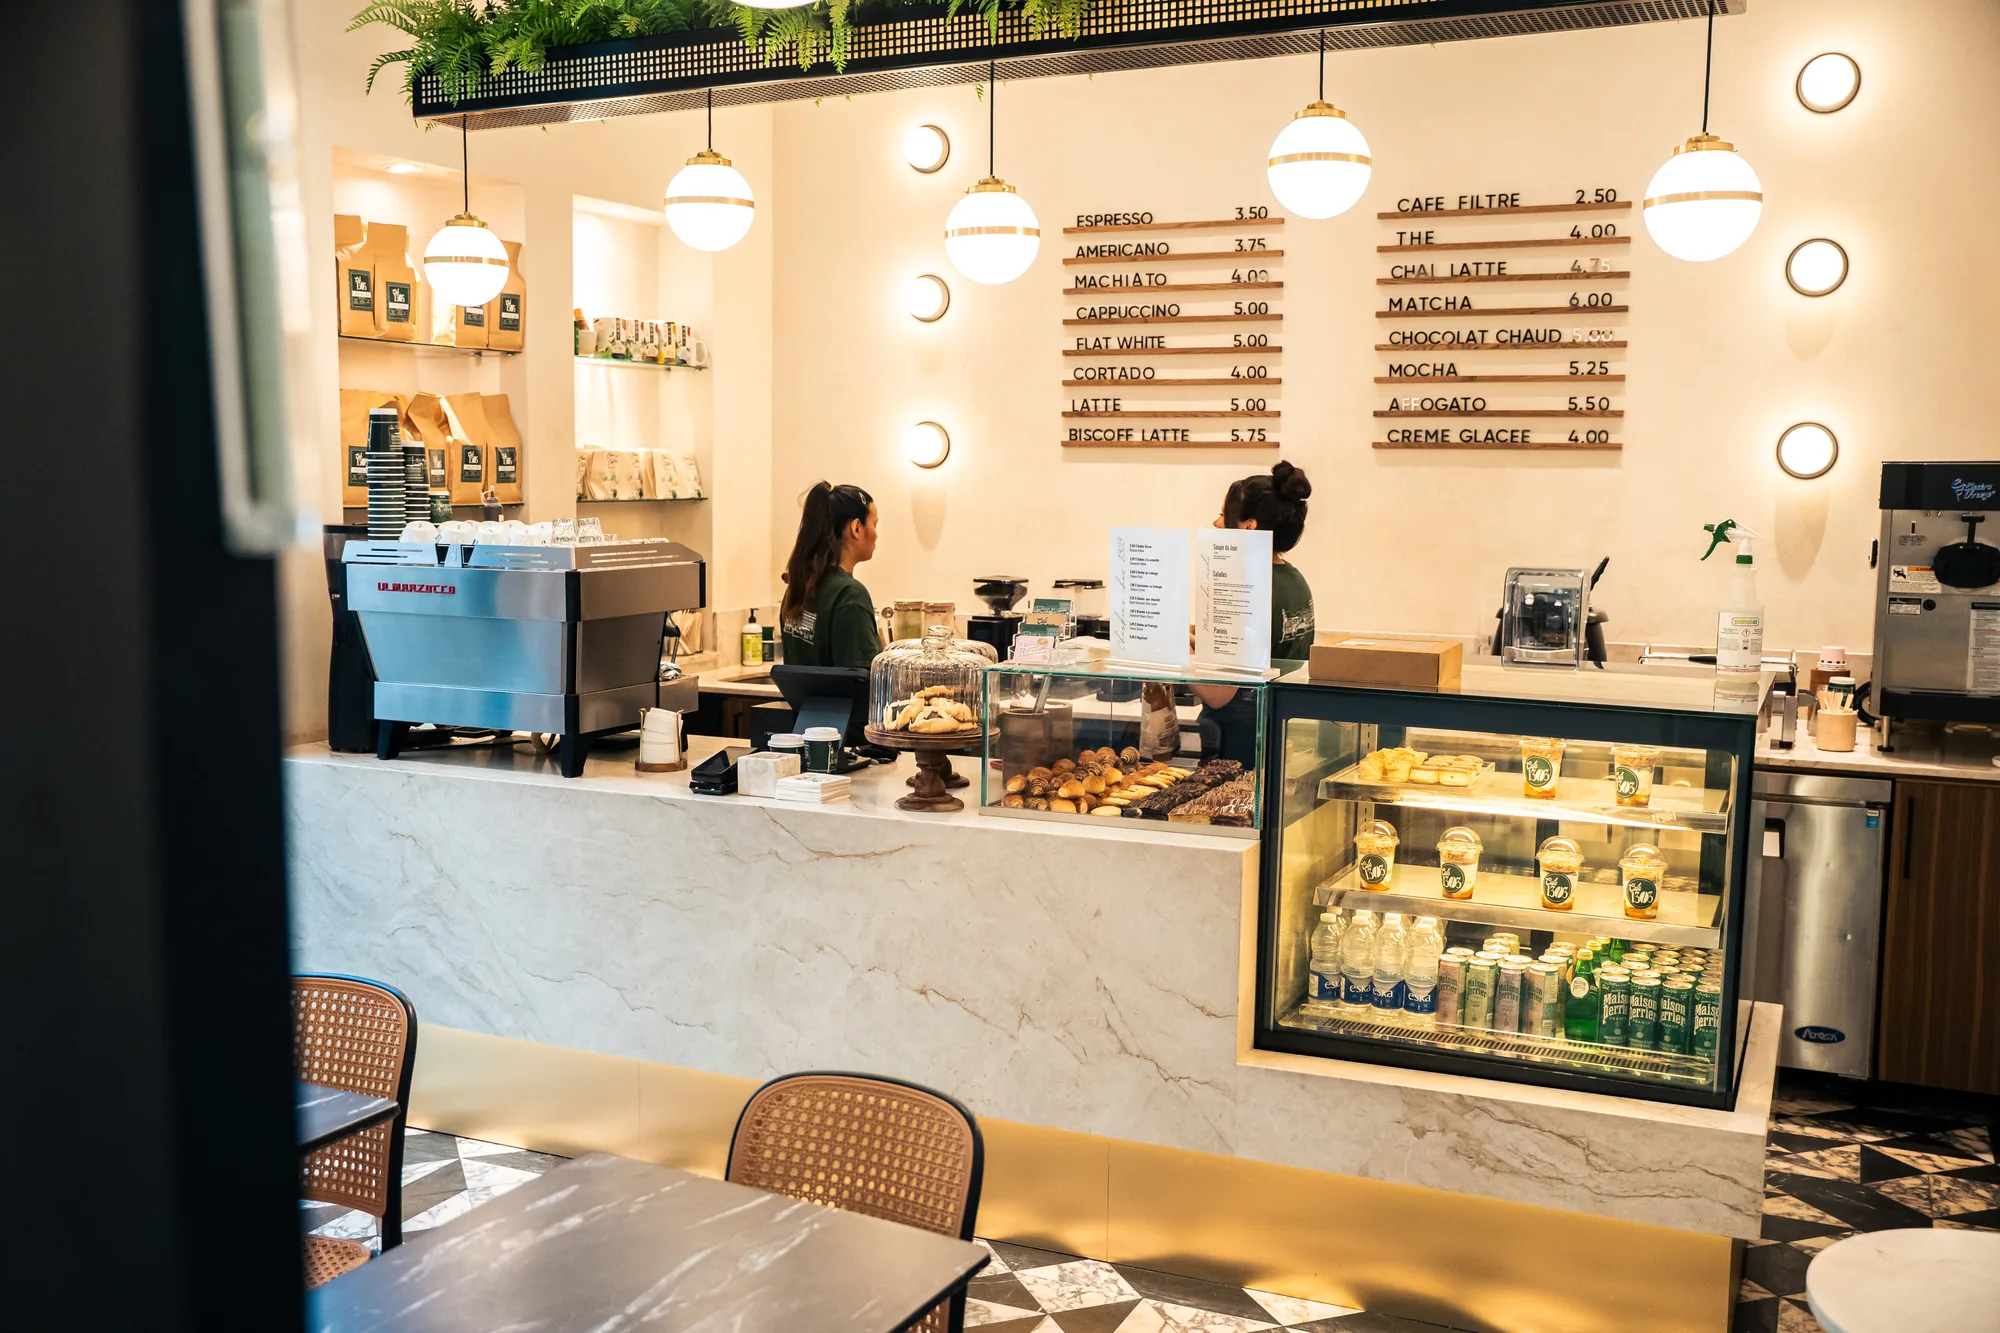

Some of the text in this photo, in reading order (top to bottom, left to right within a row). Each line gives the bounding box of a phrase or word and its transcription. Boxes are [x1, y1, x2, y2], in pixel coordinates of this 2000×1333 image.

[1397, 189, 1617, 213] CAFE FILTRE 2.50
[1077, 206, 1268, 228] ESPRESSO 3.50
[1396, 224, 1616, 246] THE 4.00
[1076, 238, 1266, 259] AMERICANO 3.75
[1391, 258, 1610, 279] CHAI LATTE 4.75
[1075, 269, 1268, 289] MACHIATO 4.00
[1389, 292, 1612, 312] MATCHA 6.00
[1076, 302, 1268, 320] CAPPUCCINO 5.00
[1077, 334, 1267, 350] FLAT WHITE 5.00
[1389, 328, 1613, 345] CHOCOLAT CHAUD 5.00
[1073, 366, 1267, 380] CORTADO 4.00
[1389, 361, 1609, 377] MOCHA 5.25
[1072, 398, 1266, 412] LATTE 5.00
[1389, 396, 1610, 411] AFFOGATO 5.50
[1069, 429, 1266, 442] BISCOFF LATTE 5.75
[1387, 429, 1609, 444] CREME GLACEE 4.00
[1528, 769, 1550, 782] 1303
[1365, 865, 1386, 880] 1303
[1547, 885, 1569, 899] 1303
[1631, 891, 1654, 904] 1303
[1325, 980, 1340, 989] esk
[1373, 987, 1394, 998] eska
[1408, 992, 1431, 1002] eska
[1661, 998, 1686, 1016] aison
